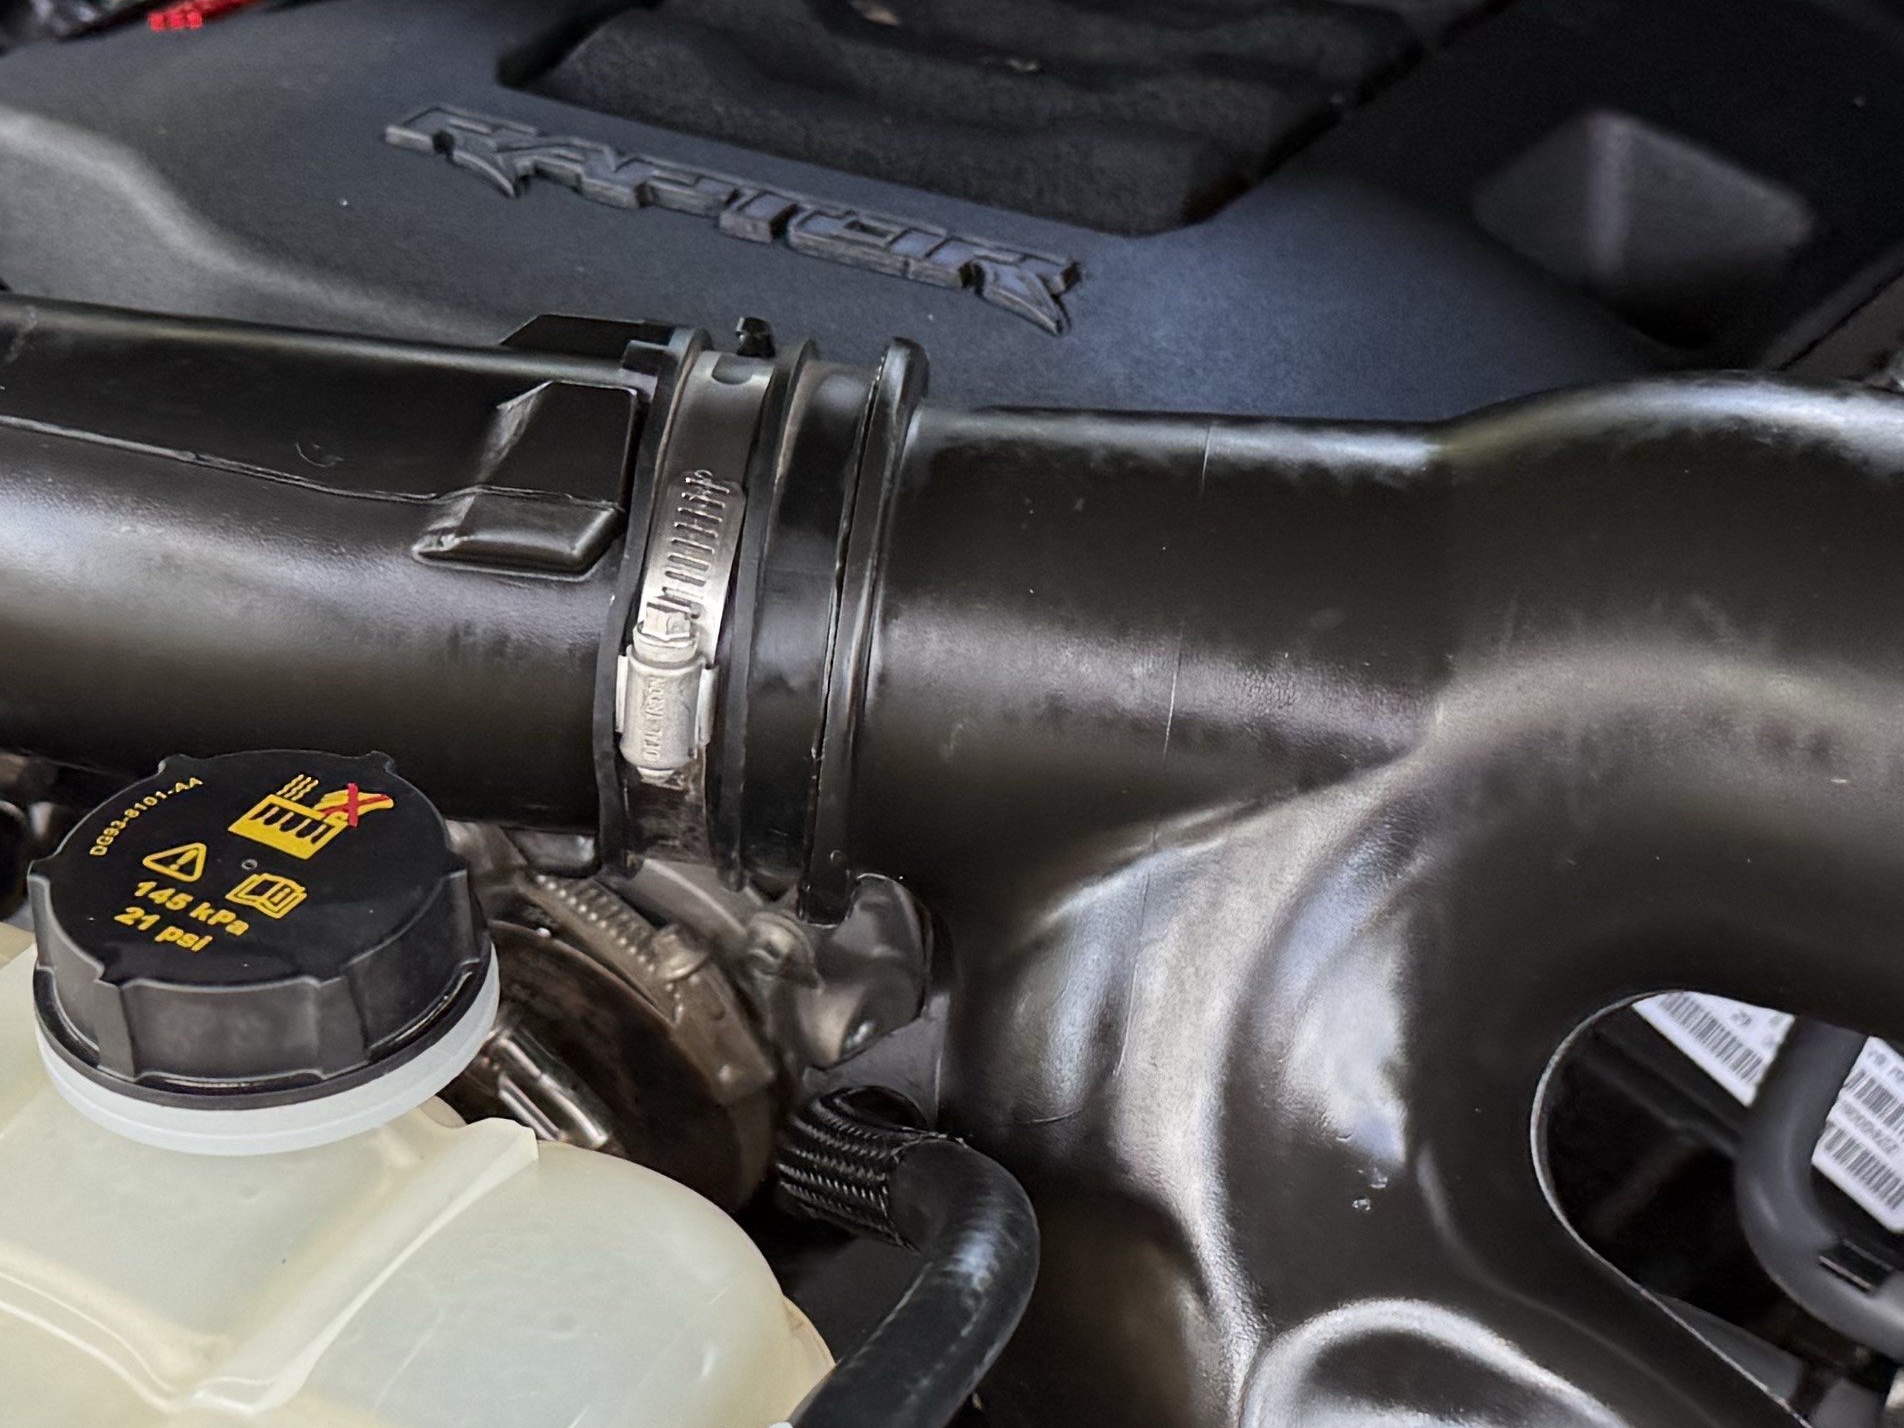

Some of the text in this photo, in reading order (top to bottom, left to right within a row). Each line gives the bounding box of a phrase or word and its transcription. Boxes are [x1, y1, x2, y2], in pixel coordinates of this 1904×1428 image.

[384, 103, 1081, 337] RAPTOR
[114, 907, 213, 954] 21 psi
[135, 881, 250, 937] 145 kPa
